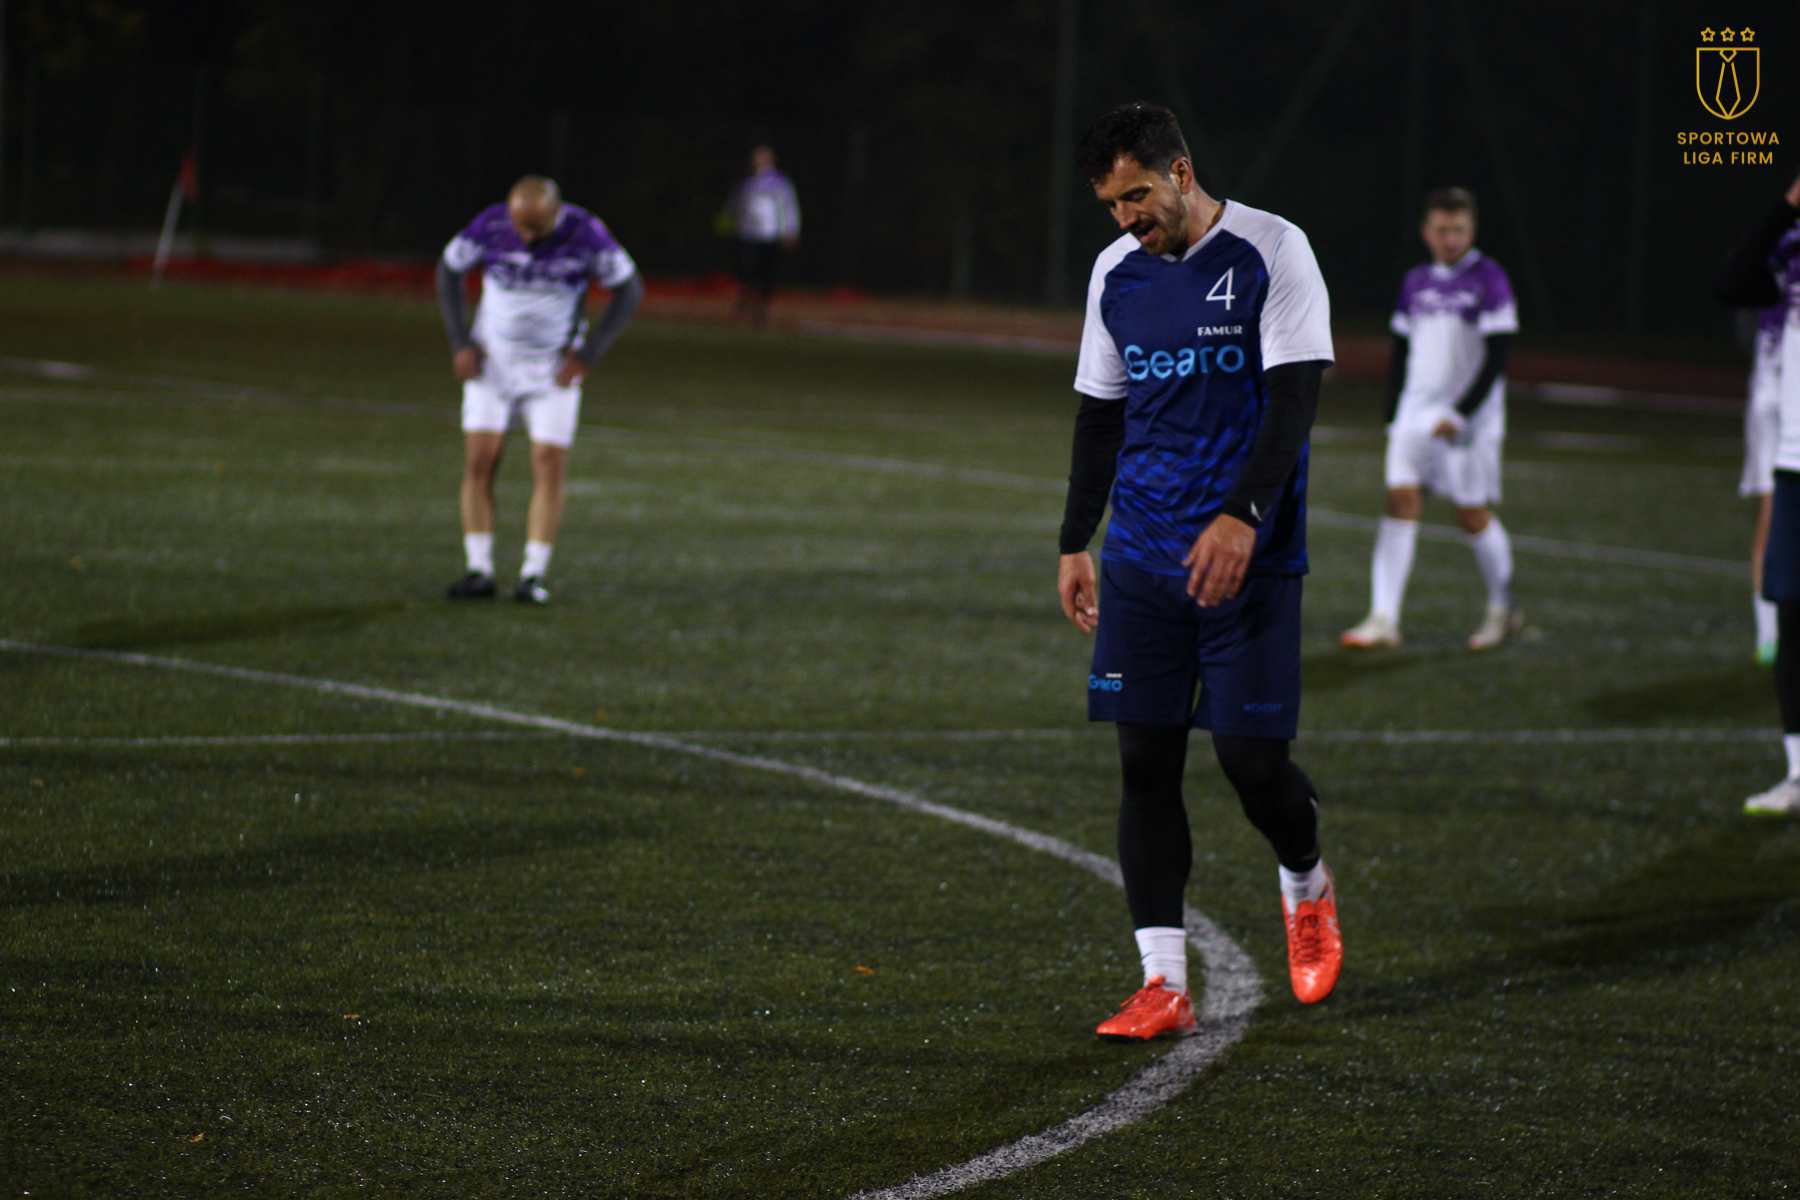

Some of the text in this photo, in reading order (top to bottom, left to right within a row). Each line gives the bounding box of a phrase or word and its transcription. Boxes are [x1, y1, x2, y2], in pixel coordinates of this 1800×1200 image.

[1205, 266, 1236, 311] 4
[1197, 325, 1243, 337] FAMUR
[1124, 344, 1245, 381] Gearo
